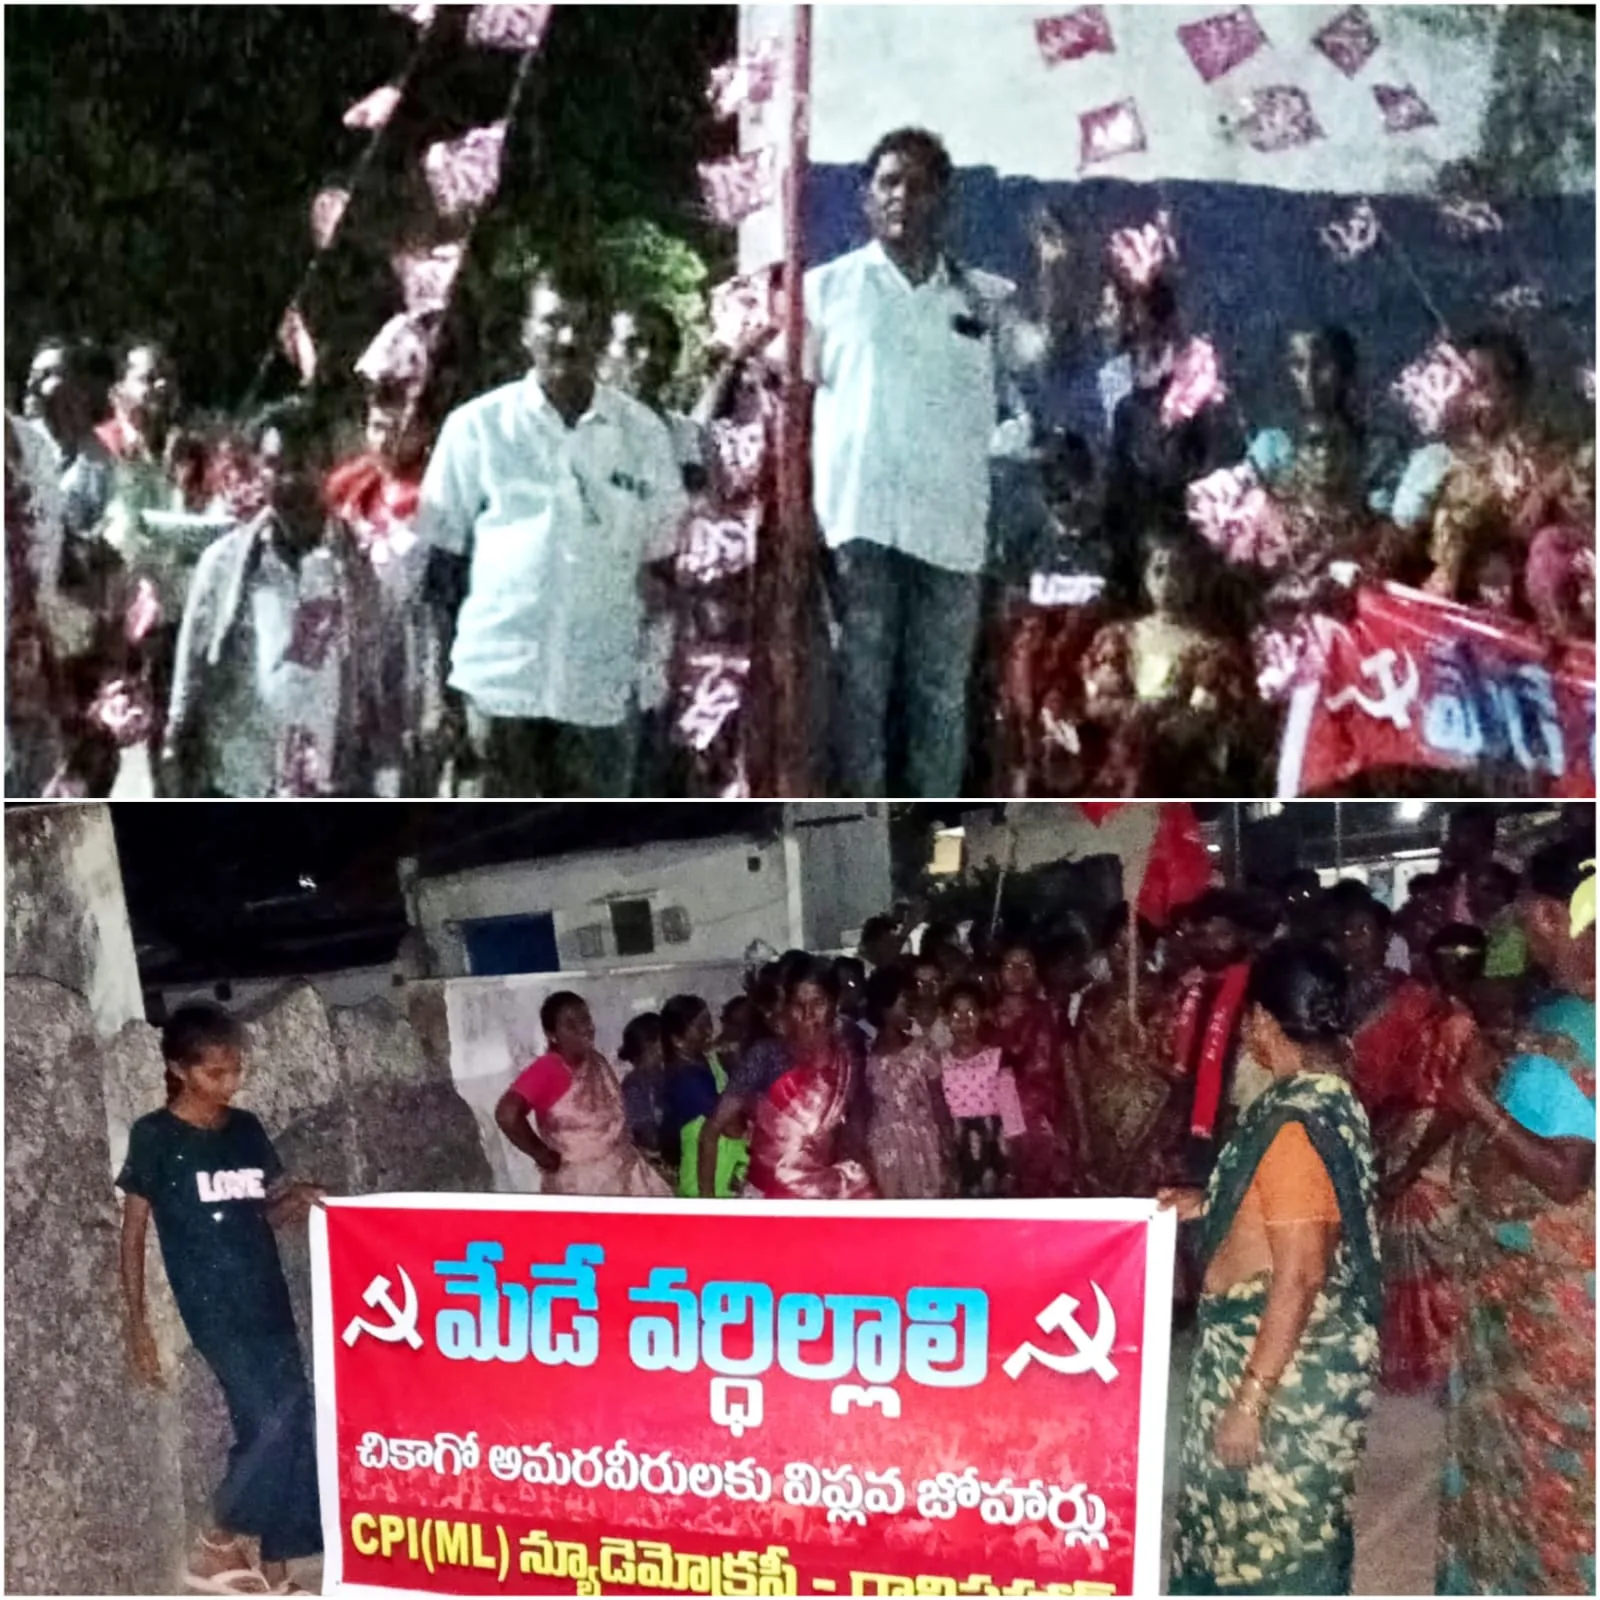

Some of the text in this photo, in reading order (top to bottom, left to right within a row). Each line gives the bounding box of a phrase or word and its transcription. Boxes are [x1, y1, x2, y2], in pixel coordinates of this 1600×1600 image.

[196, 1168, 265, 1202] LOVE
[434, 1241, 989, 1437] మేడే వర్ధిల్లాలి
[355, 1431, 1109, 1550] చికాగో అమరవీరులకు విప్లవ జోహార్లు
[351, 1512, 511, 1582] CPI(ML)
